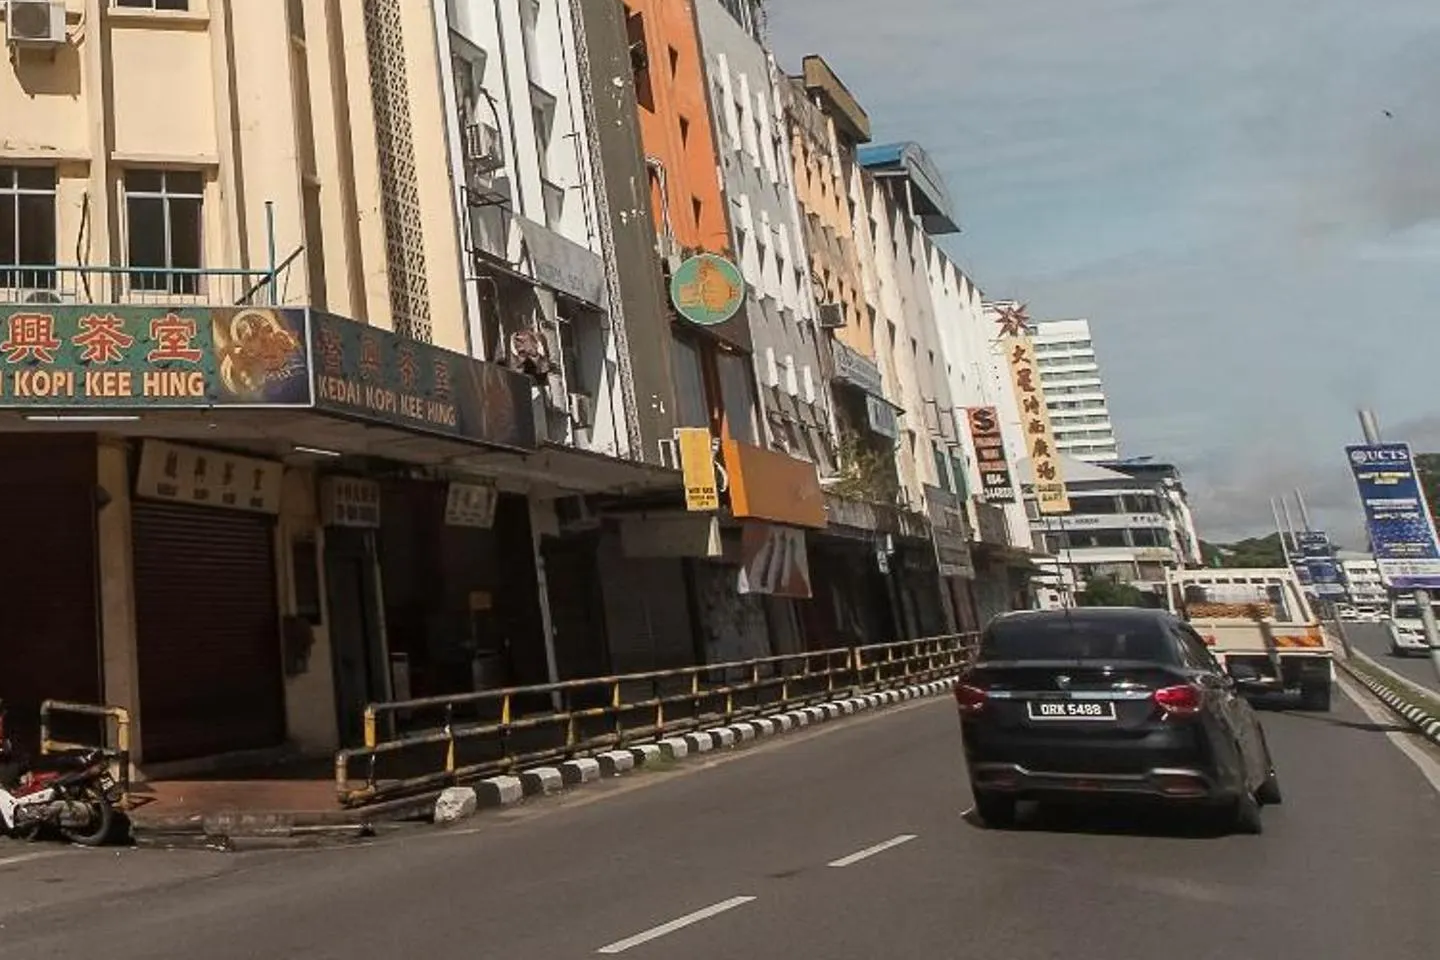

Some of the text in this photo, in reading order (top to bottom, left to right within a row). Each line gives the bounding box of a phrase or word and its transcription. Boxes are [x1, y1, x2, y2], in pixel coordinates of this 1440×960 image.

[13, 369, 75, 397] KOPI
[84, 370, 133, 398] KEE
[143, 370, 205, 398] HING
[316, 374, 457, 426] KEDAI KOPI KEE HING
